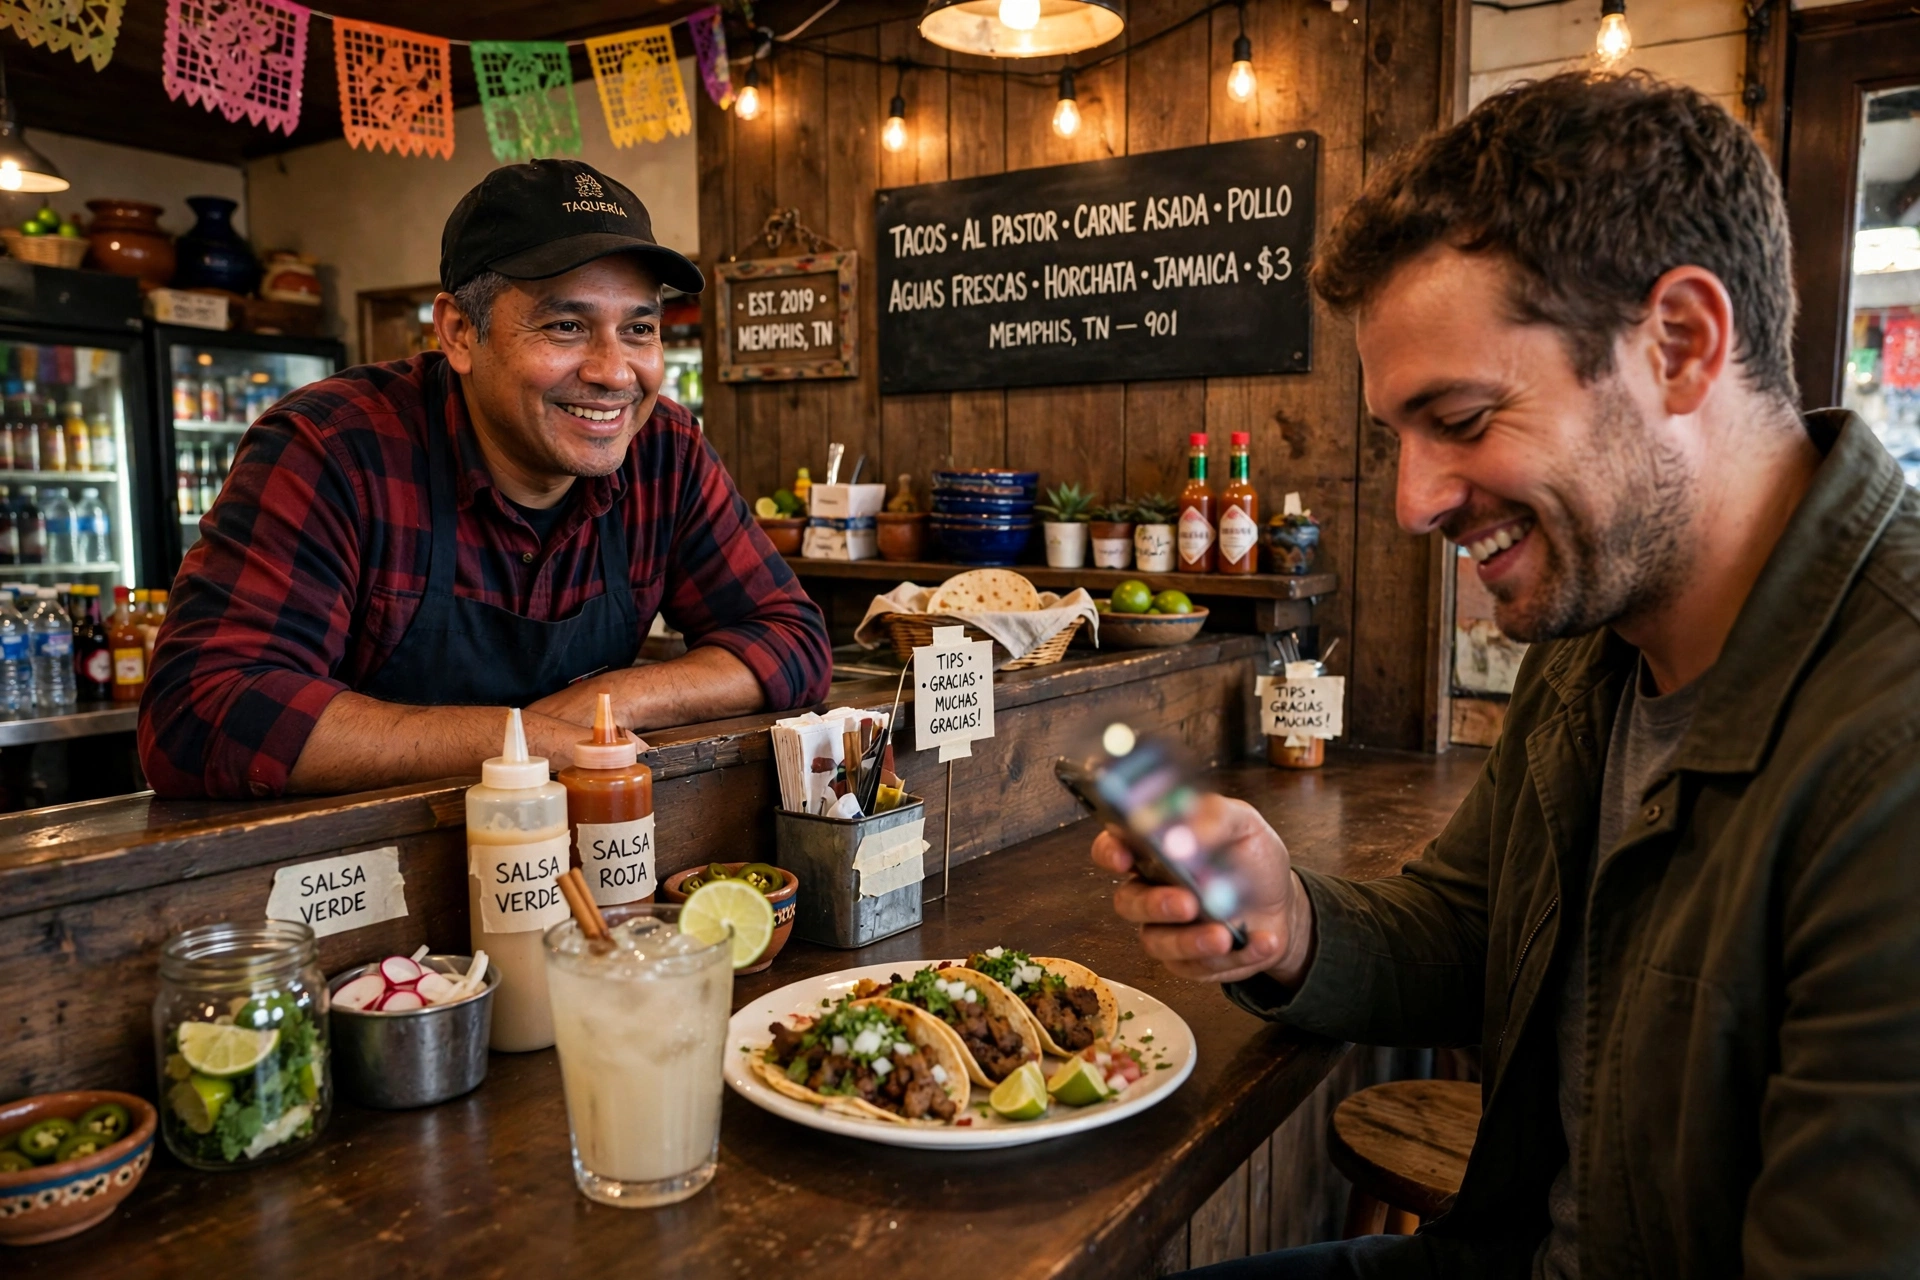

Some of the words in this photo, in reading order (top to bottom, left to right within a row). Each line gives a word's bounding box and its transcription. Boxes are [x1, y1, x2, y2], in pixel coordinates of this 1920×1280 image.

[562, 200, 628, 218] TAQUERÍA
[889, 224, 948, 258] TACOS
[961, 218, 986, 252] AL
[992, 210, 1059, 246] PASTOR
[1073, 201, 1137, 239] CARNE
[1143, 193, 1209, 232] ASADA
[1228, 185, 1292, 223] POLLO
[888, 279, 945, 313] AGUAS
[952, 272, 1027, 308] FRESCAS
[1044, 260, 1137, 300] HORCHATA
[1152, 251, 1239, 290] JAMAICA
[1257, 246, 1292, 285] $3
[747, 292, 777, 317] EST.
[780, 288, 814, 314] 2019
[738, 322, 809, 351] MEMPHIS,
[811, 320, 833, 347] TN
[989, 318, 1078, 349] MEMPHIS,
[1082, 315, 1110, 341] TN
[1144, 310, 1177, 338] 901
[936, 652, 964, 670] TIPS
[930, 672, 976, 692] GRACIAS
[1274, 686, 1306, 698] TIPS
[935, 692, 978, 712] MUCHAS
[1270, 700, 1324, 713] GRACIAS
[930, 708, 981, 734] GRACIAS!
[592, 832, 650, 861] SALSA
[301, 865, 366, 897] SALSA
[496, 856, 560, 884] SALSA
[599, 863, 648, 889] ROJA
[300, 890, 366, 924] VERDE
[495, 884, 560, 913] VERDE
